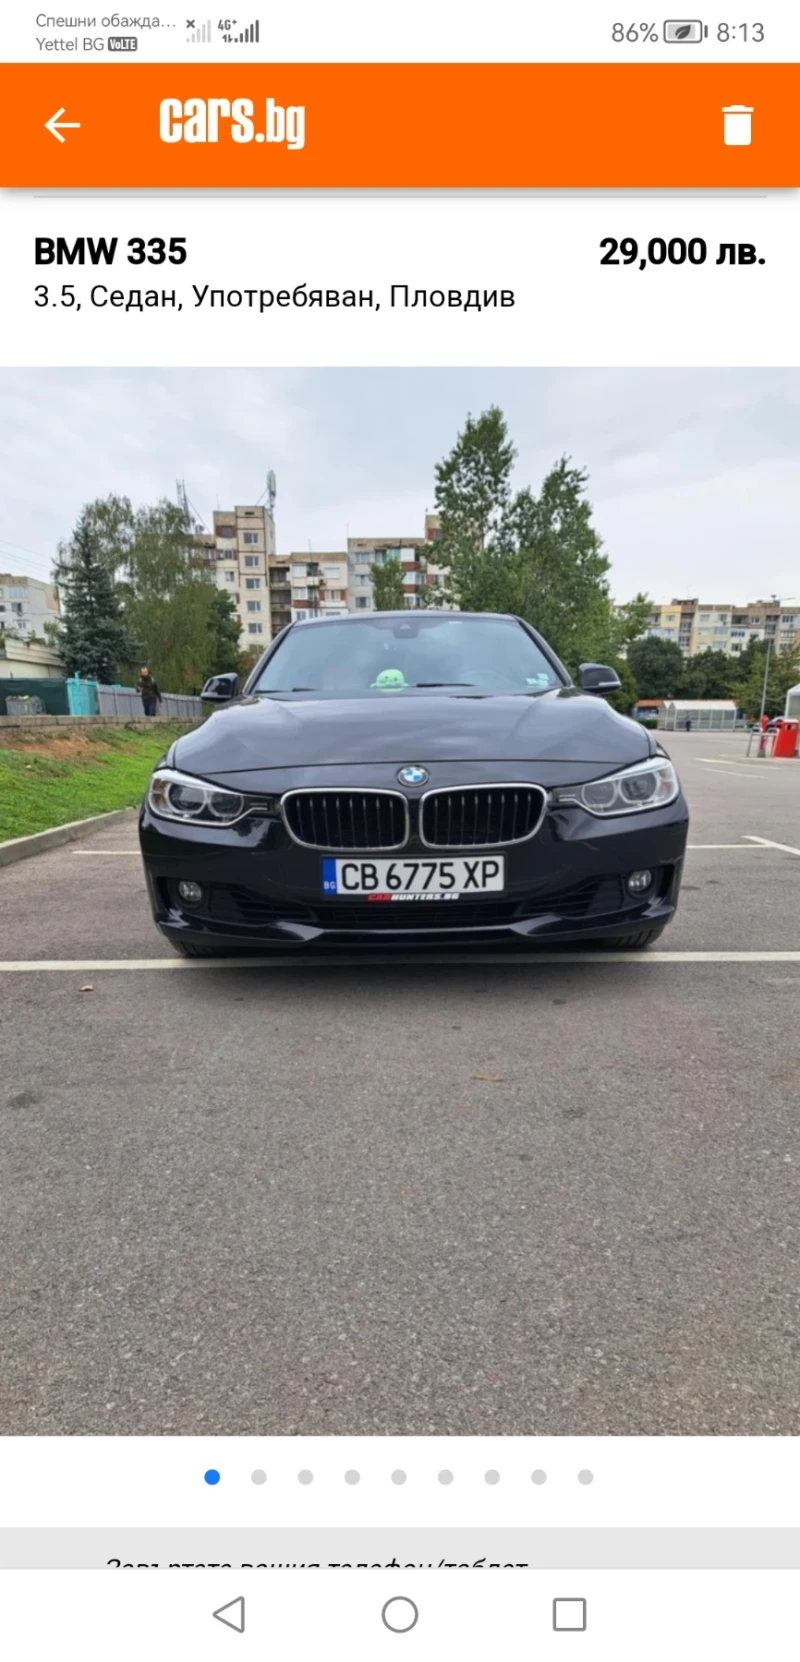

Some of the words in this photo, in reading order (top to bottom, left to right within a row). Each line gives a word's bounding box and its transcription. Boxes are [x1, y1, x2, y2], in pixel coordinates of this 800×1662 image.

[36, 14, 96, 28] Спешни
[611, 22, 659, 43] 86%
[716, 22, 765, 43] 8:13
[36, 37, 78, 51] Yettel
[83, 37, 105, 51] BG
[108, 37, 138, 52] VoLTE
[159, 97, 305, 150] cars.bg
[34, 237, 118, 265] BMW
[126, 237, 187, 265] 335
[599, 237, 708, 270] 29,000
[715, 243, 766, 265] лв.
[34, 284, 82, 312] 3.5,
[90, 284, 183, 313] Седан,
[192, 282, 381, 314] Употребяван,
[390, 284, 516, 313] Пловдив
[323, 881, 336, 890] BG
[341, 863, 379, 891] CB
[385, 862, 456, 890] 6775
[462, 860, 499, 889] XP
